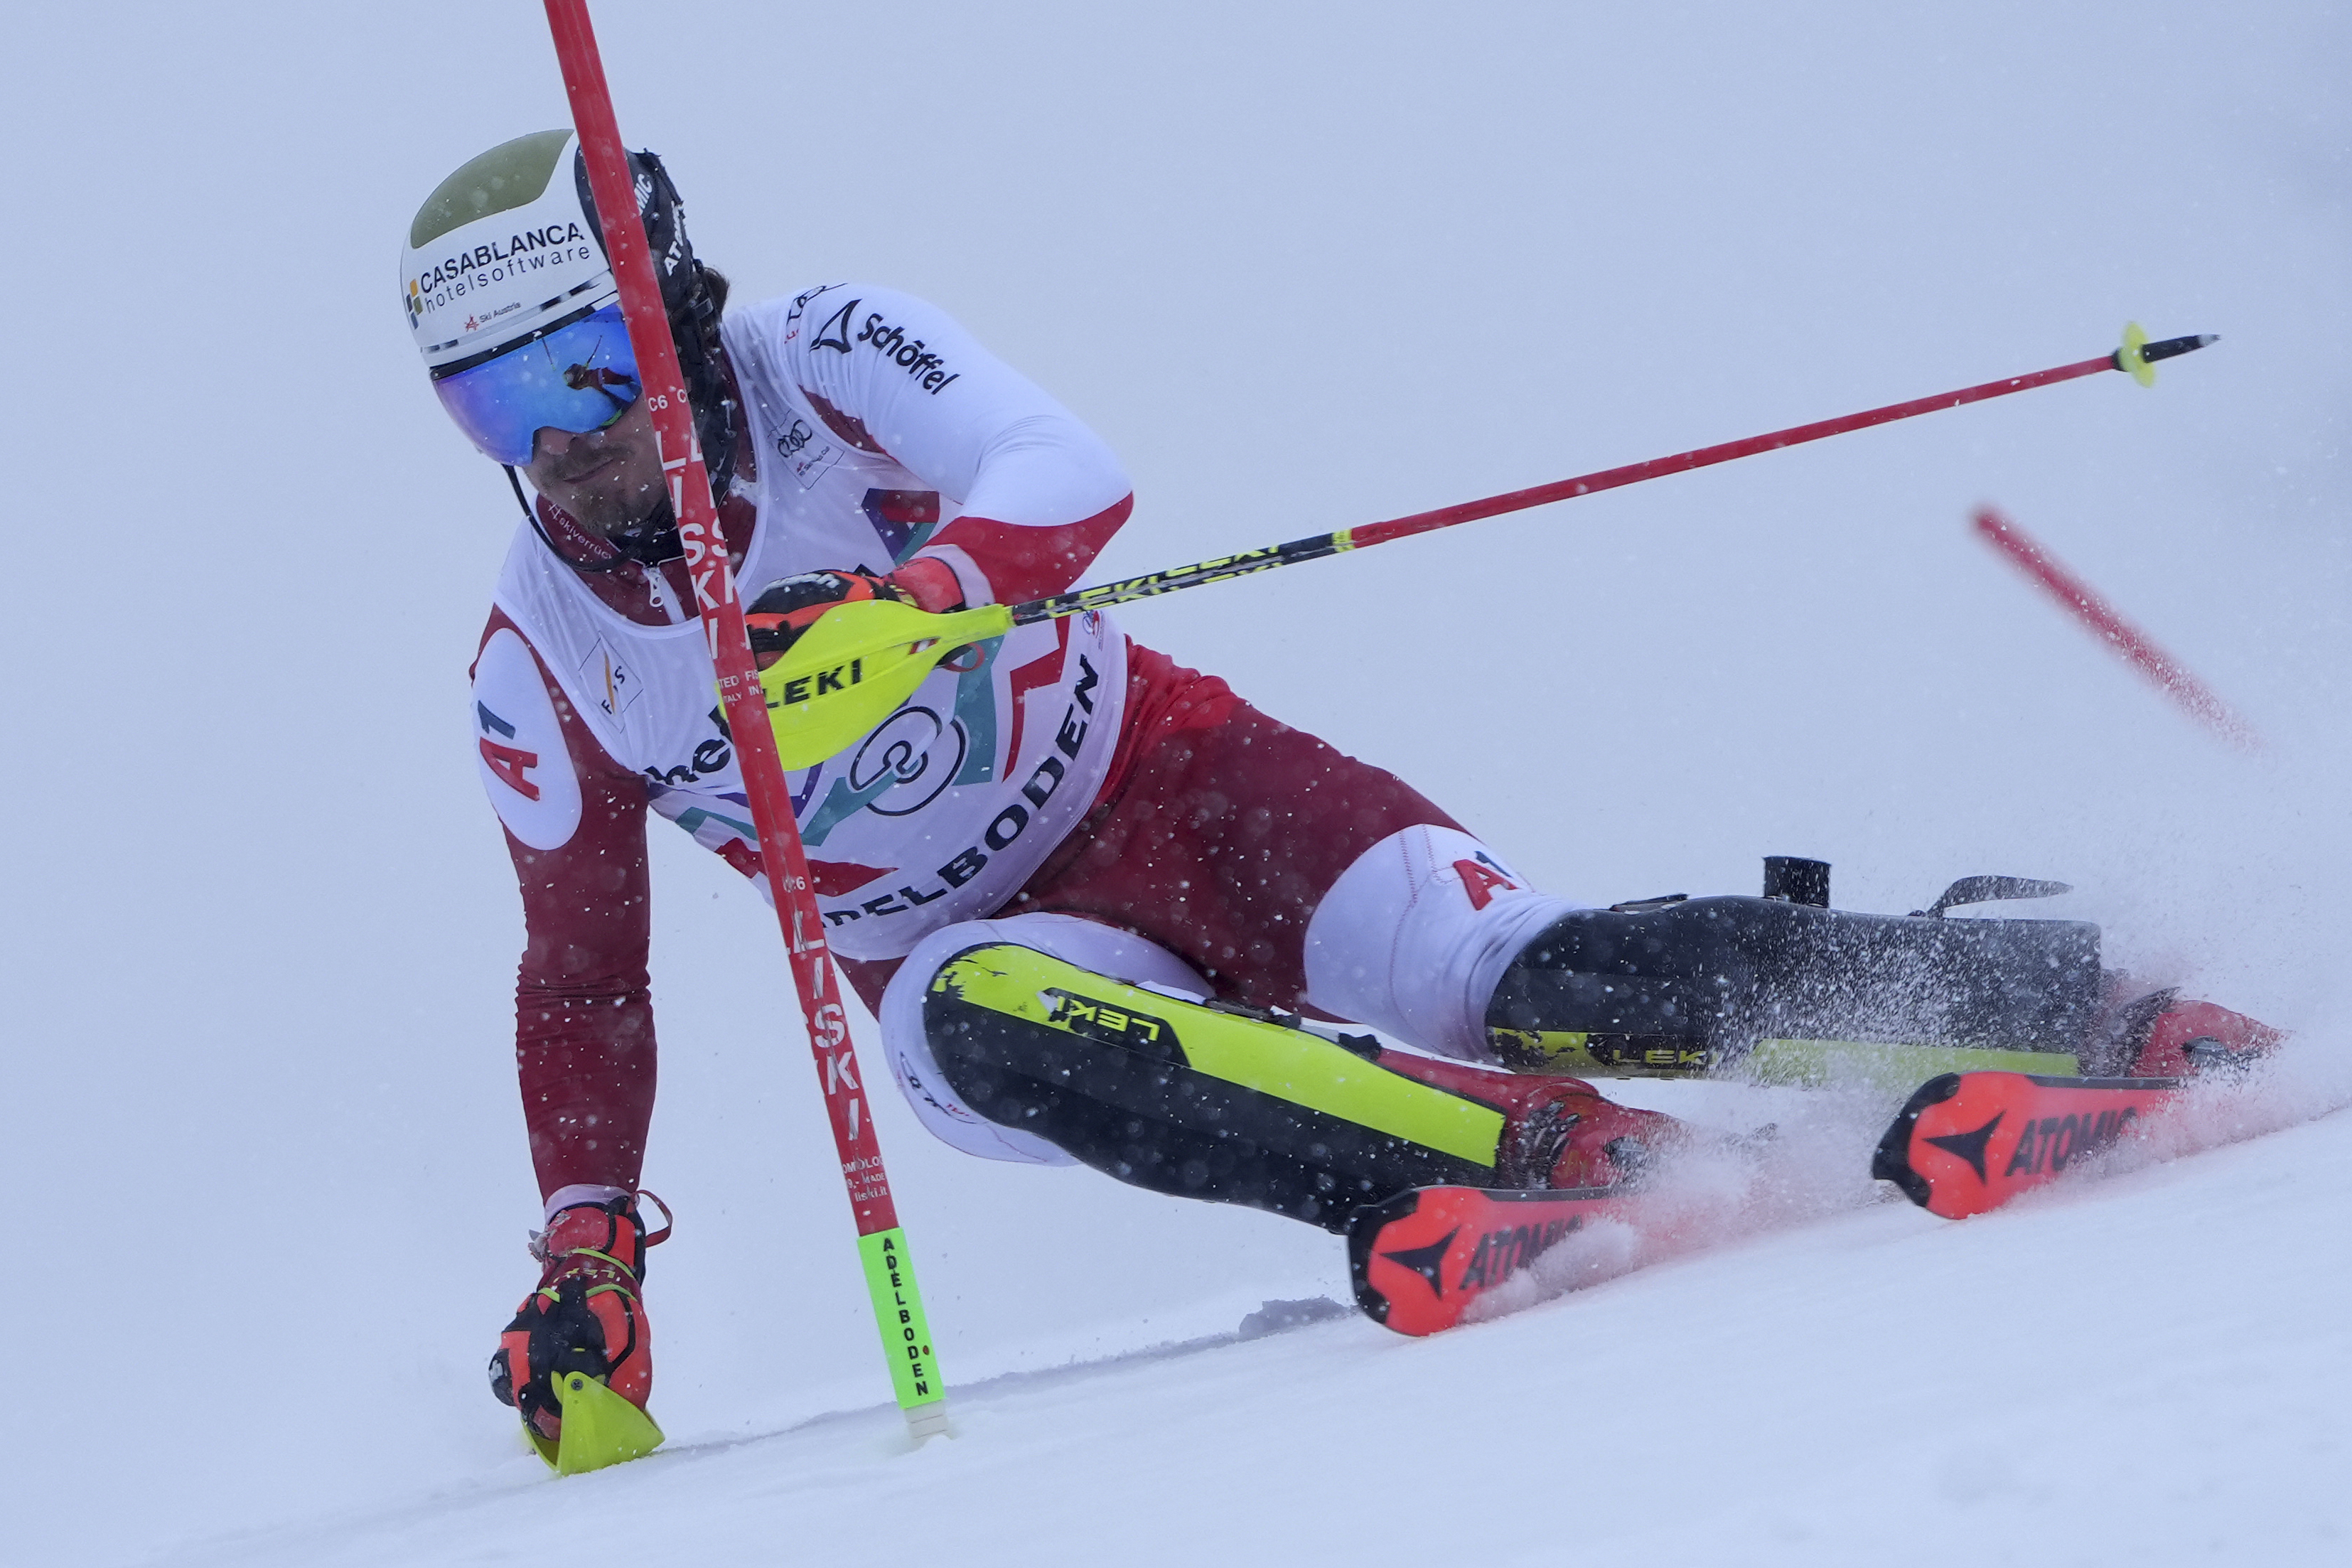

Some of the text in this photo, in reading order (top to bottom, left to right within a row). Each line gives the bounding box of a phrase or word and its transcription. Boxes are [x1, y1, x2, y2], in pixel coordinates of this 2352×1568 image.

[634, 173, 653, 217] MIC
[420, 222, 584, 294] CASABLANCA
[424, 246, 590, 314] hotelsoftware
[479, 301, 522, 323] Ski Austria
[857, 313, 960, 395] Schöffel
[648, 389, 687, 412] C6 C
[655, 430, 720, 660] LISKI
[719, 675, 740, 688] TED
[723, 692, 742, 703] TALY
[762, 657, 861, 708] LEKI
[478, 699, 540, 802] A1
[822, 653, 1099, 928] DELBODEN
[1452, 850, 1520, 911] A1
[793, 907, 859, 1141] LISKI
[1056, 995, 1160, 1041] LEKI
[883, 1237, 929, 1396] ADELBODEN
